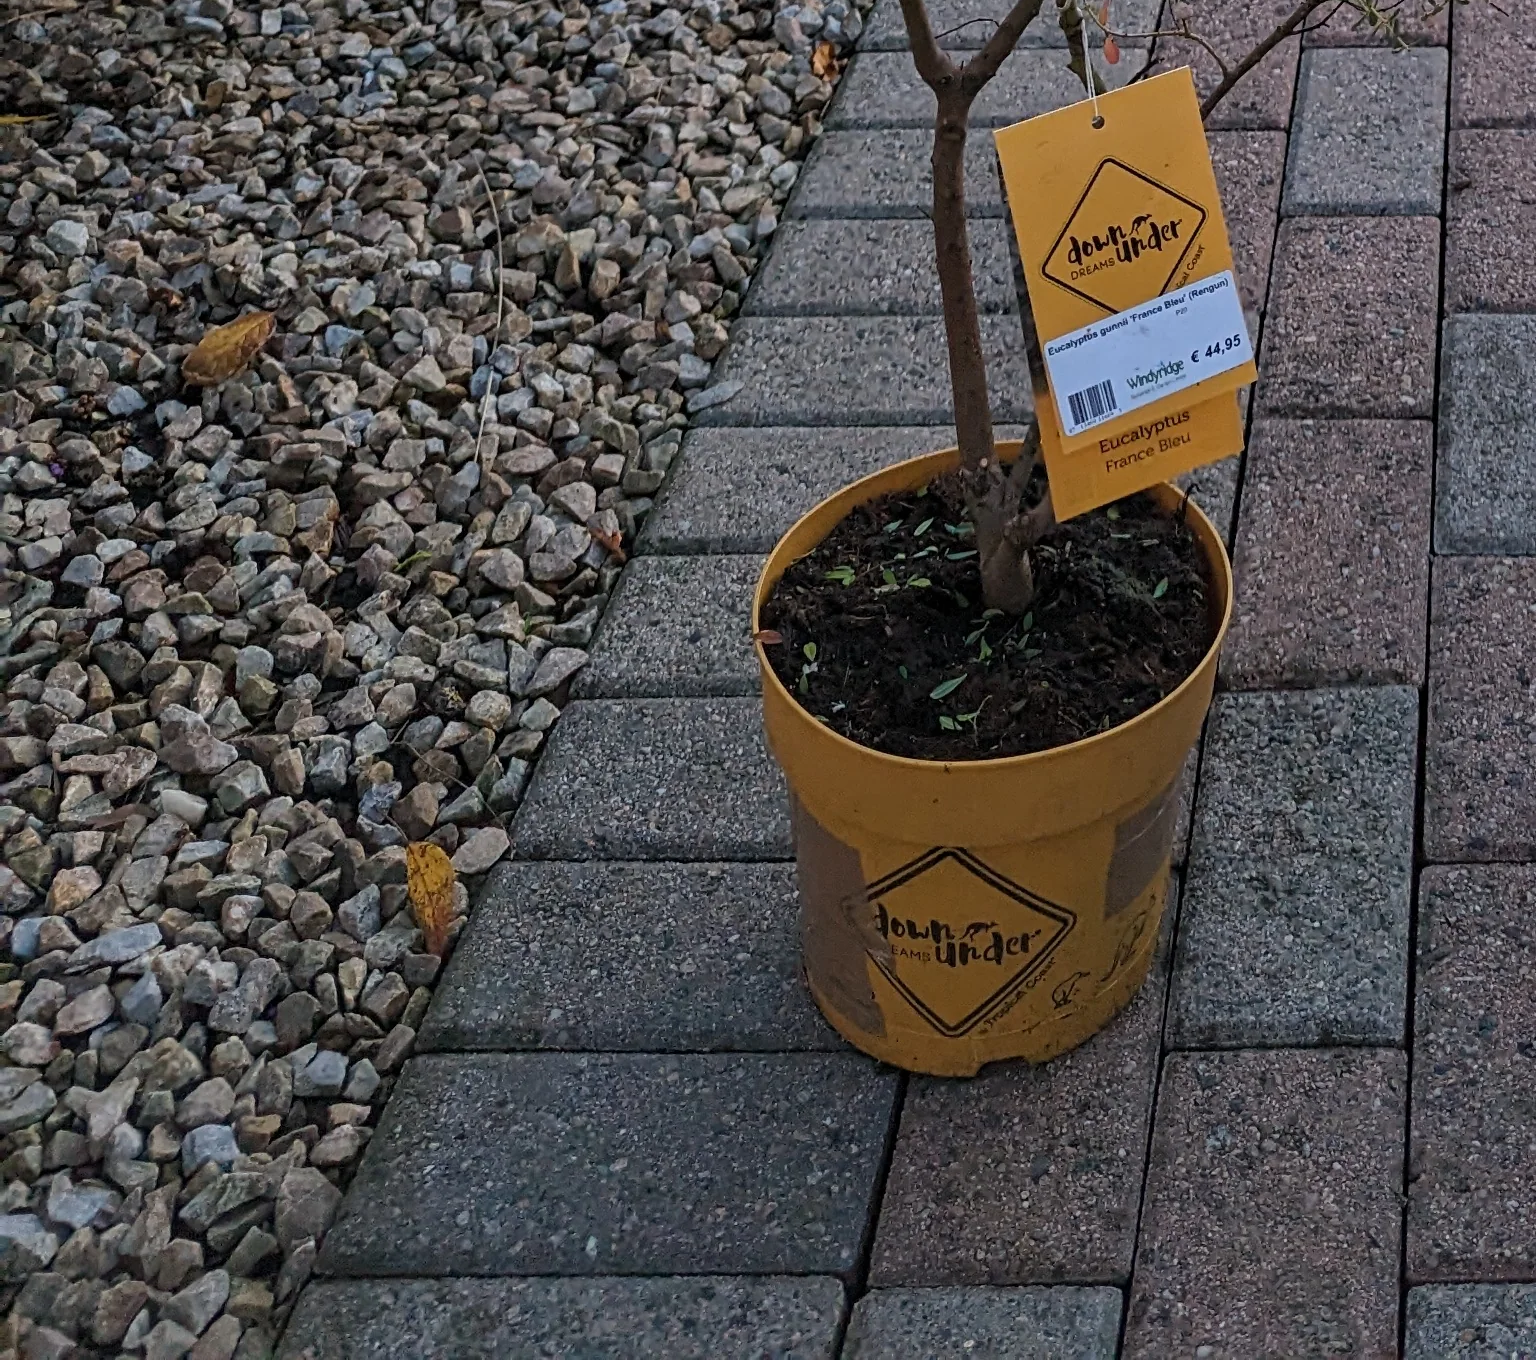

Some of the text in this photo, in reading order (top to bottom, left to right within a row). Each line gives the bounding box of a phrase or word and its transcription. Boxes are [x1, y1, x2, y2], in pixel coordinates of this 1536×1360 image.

[1067, 218, 1183, 267] down under
[1186, 243, 1206, 272] Coast
[1070, 257, 1116, 281] DREAMS
[1047, 329, 1099, 357] Eucalyptus
[1099, 317, 1129, 338] gunnii
[1188, 277, 1230, 301] (Rengun)
[1126, 359, 1185, 391] Windyridge
[1190, 350, 1200, 364] €
[1204, 333, 1242, 359] 44,95
[1098, 410, 1191, 454] Eucalyptus
[1106, 431, 1191, 473] France Bleu
[873, 902, 1042, 968] down under
[891, 943, 931, 962] EAMS
